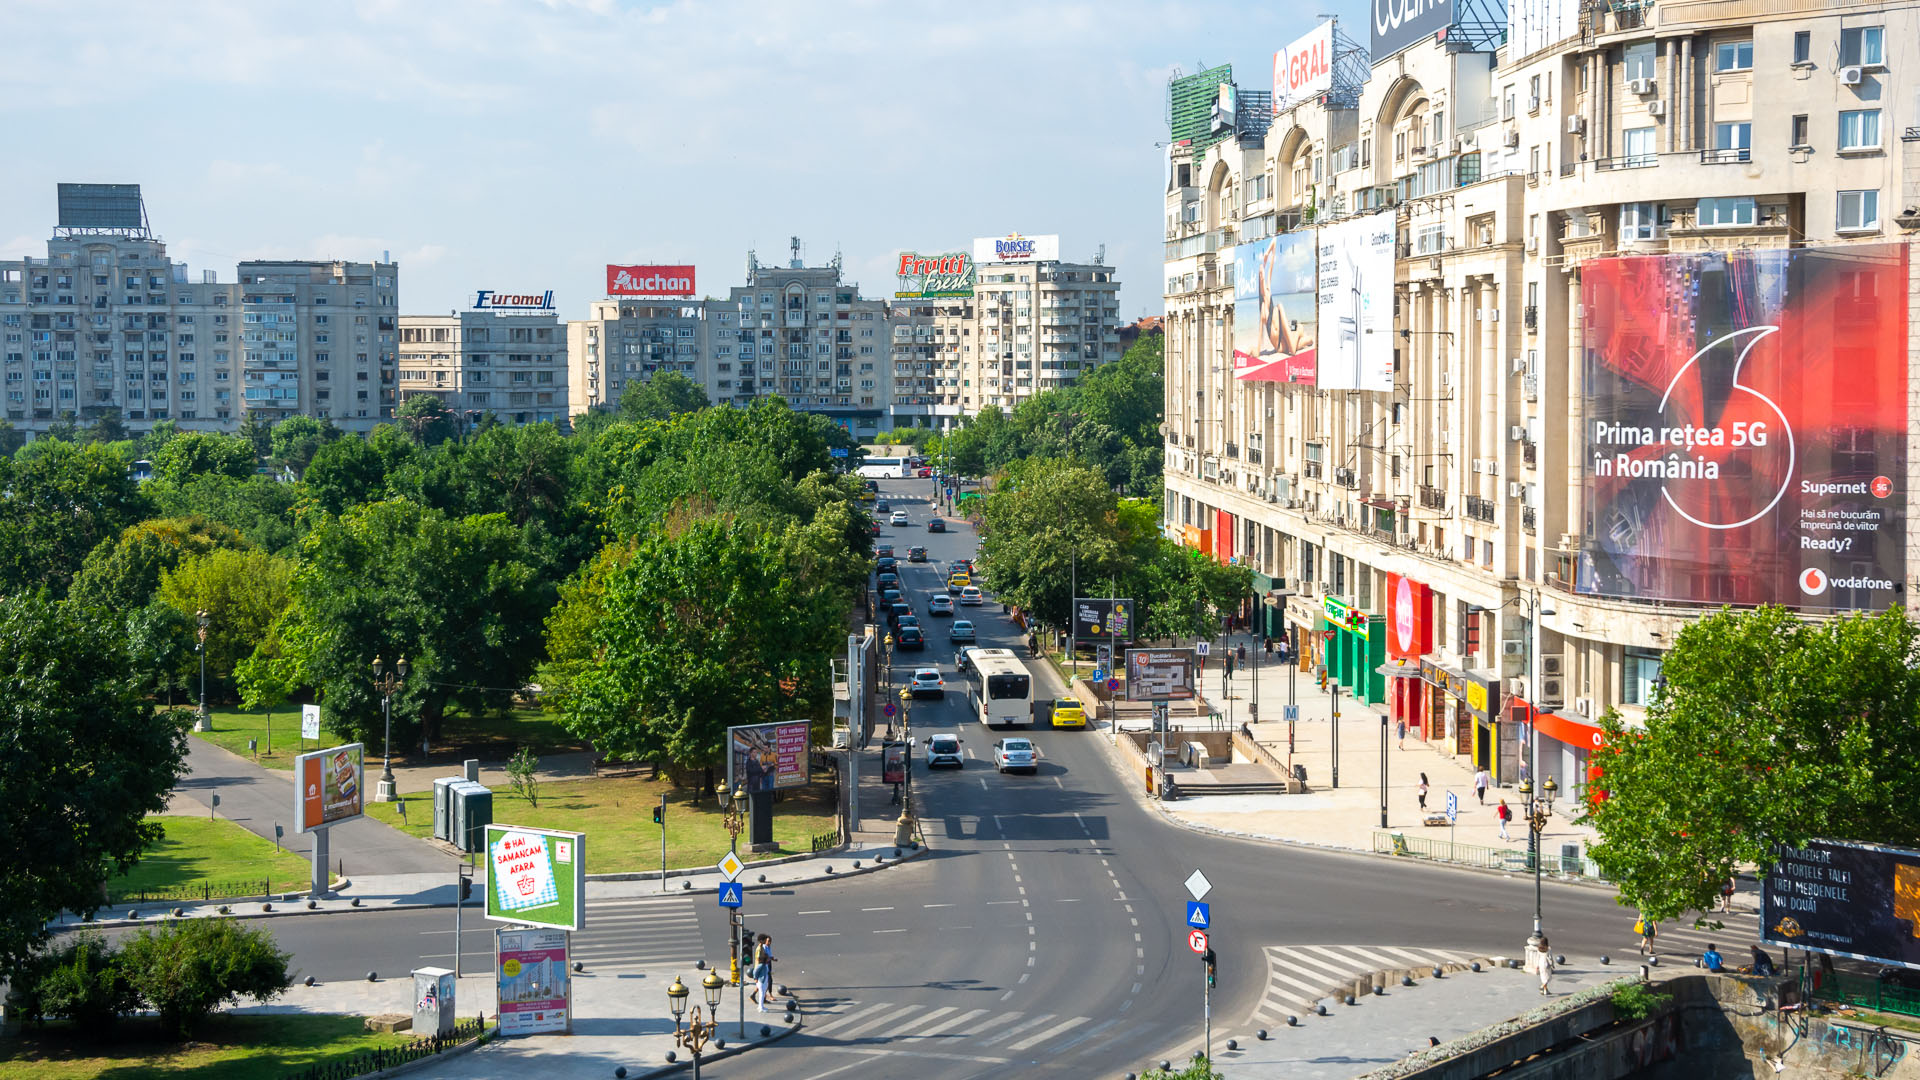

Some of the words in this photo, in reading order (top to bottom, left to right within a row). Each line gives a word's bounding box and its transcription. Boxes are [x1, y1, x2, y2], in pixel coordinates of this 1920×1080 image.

[1289, 39, 1328, 90] GRAL
[995, 239, 1035, 253] BORSEC
[898, 254, 964, 275] Frutti
[613, 270, 690, 290] Auchan
[922, 265, 973, 294] Fresh
[473, 290, 556, 310] Euromall
[1596, 421, 1654, 445] Prima
[1731, 421, 1767, 447] 5G
[1594, 452, 1612, 477] în
[1616, 453, 1719, 480] România
[1801, 480, 1867, 496] Supernet
[1876, 483, 1888, 491] 5G
[1801, 509, 1816, 518] Hai
[1817, 510, 1827, 518] să
[1828, 511, 1839, 519] ne
[1840, 510, 1880, 520] bucurăm
[1800, 520, 1842, 531] împreună
[1843, 522, 1855, 530] de
[1856, 522, 1879, 531] viitor
[1800, 536, 1852, 553] Ready?
[1830, 576, 1893, 590] vodafone
[1198, 644, 1208, 653] M
[1095, 670, 1102, 678] P
[1286, 708, 1296, 719] M
[510, 861, 535, 874] AFARA
[1773, 878, 1791, 892] TREI
[1773, 894, 1786, 908] NU
